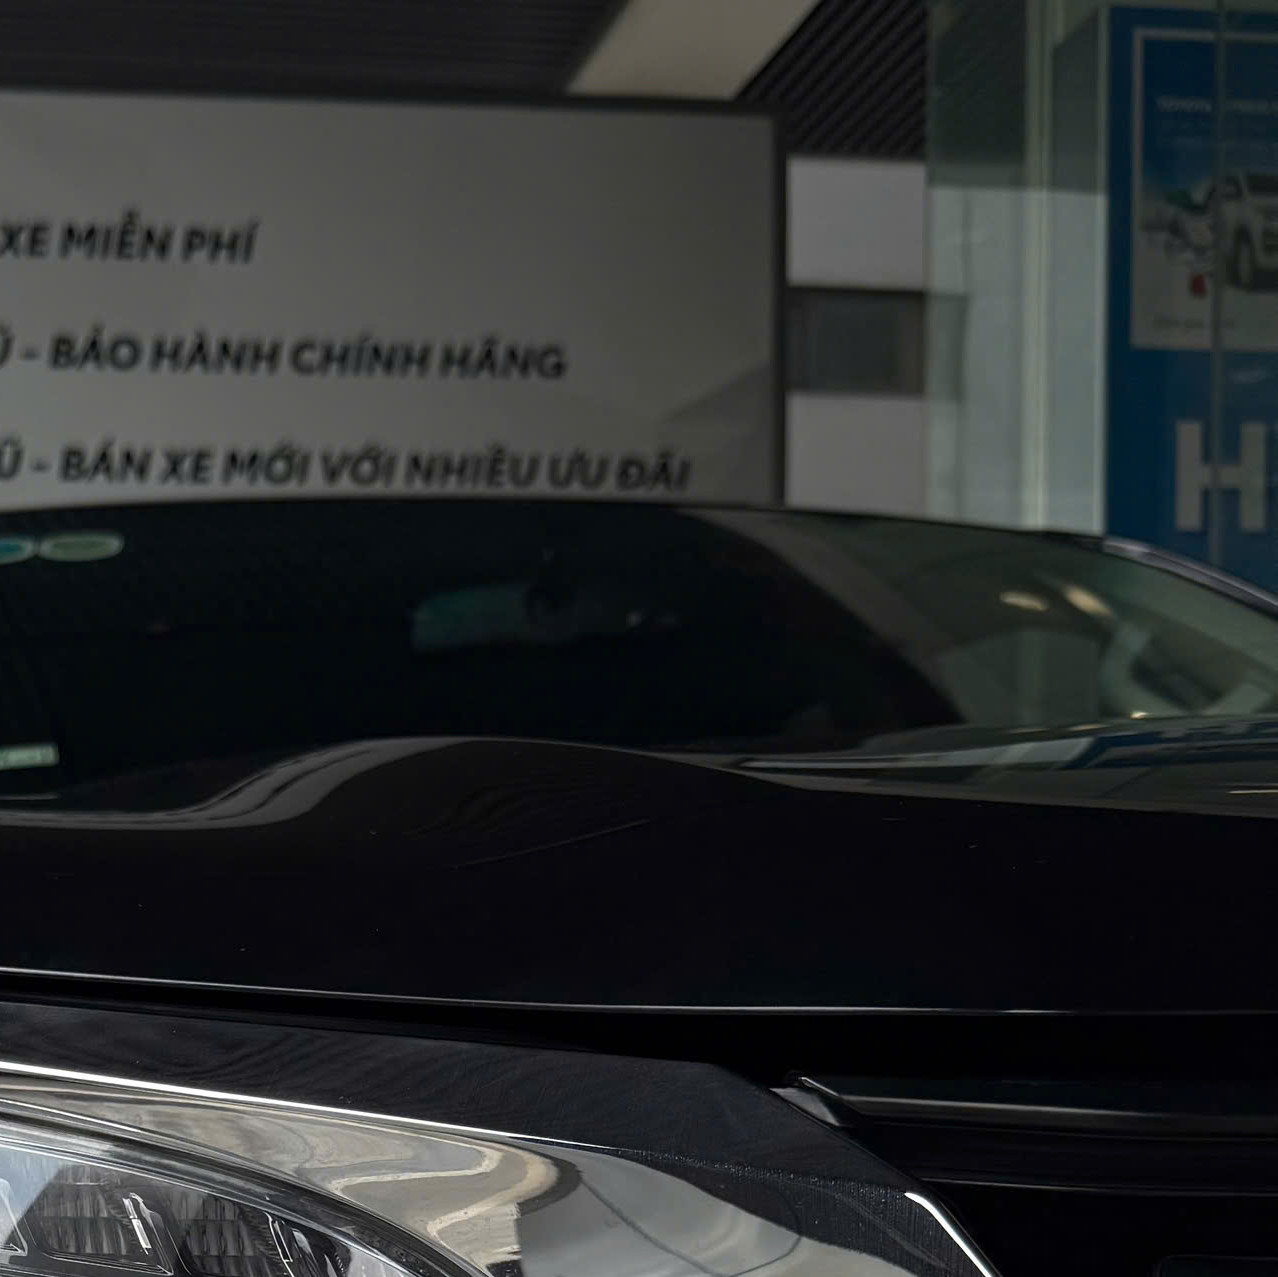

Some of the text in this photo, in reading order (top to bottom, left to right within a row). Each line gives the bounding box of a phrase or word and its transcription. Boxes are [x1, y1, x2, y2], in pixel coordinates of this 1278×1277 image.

[182, 218, 260, 264] PHÍ
[289, 333, 433, 378] CHÍNH
[59, 438, 153, 483] BÁN
[161, 446, 214, 485] XE
[220, 441, 309, 486] MỚI
[319, 441, 397, 487] VỚI
